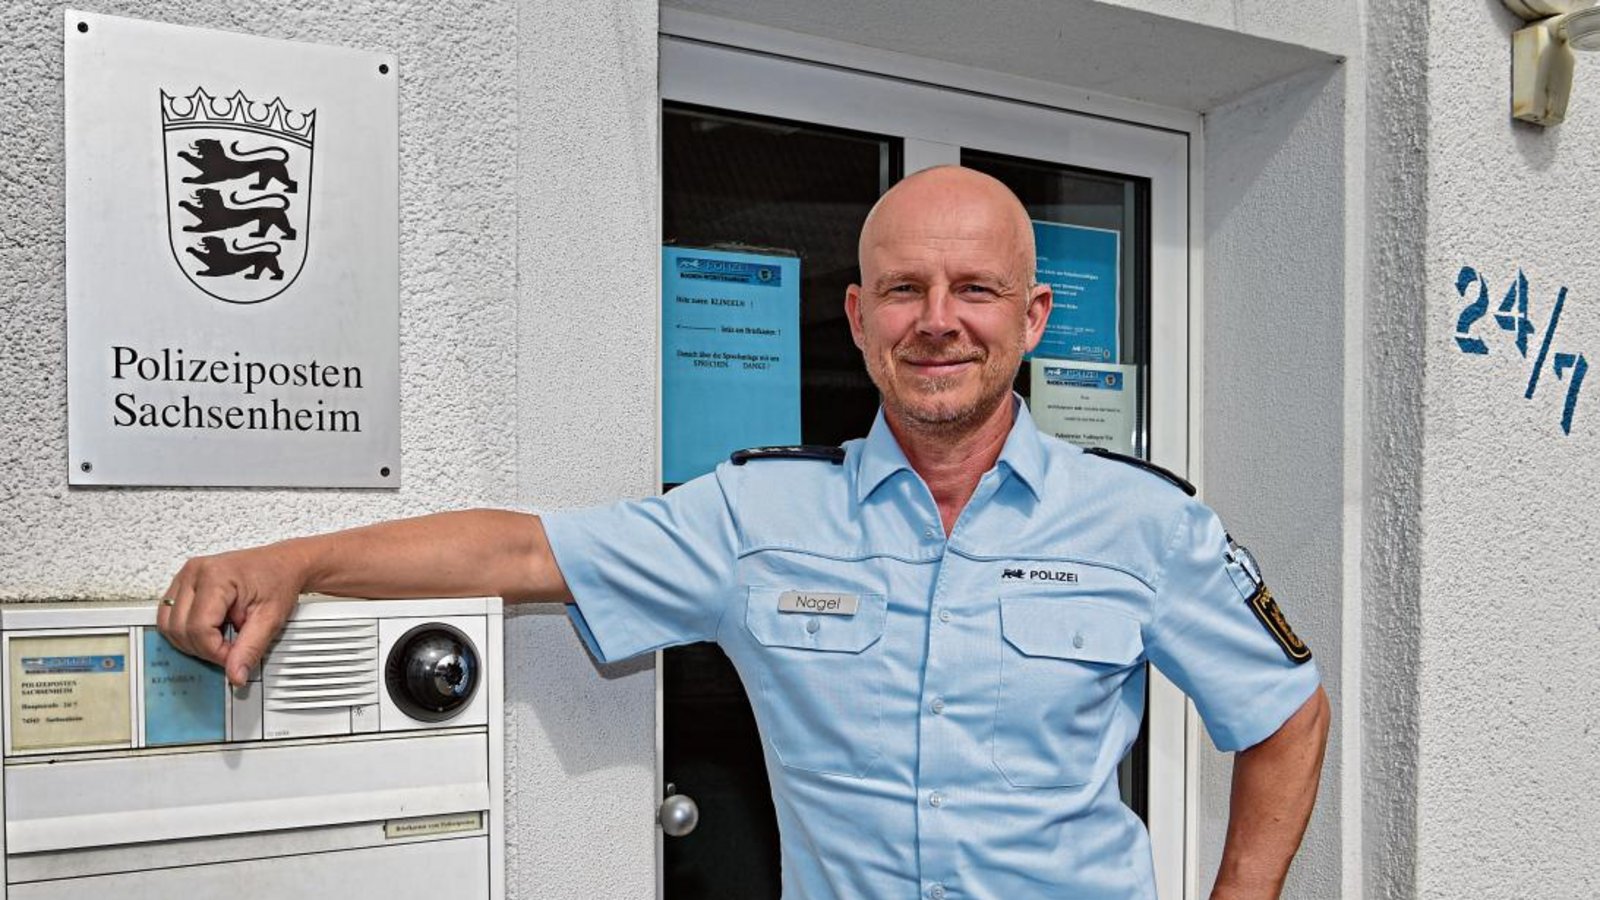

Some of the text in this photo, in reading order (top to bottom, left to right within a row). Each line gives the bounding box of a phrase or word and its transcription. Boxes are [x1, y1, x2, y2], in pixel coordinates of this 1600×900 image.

[1454, 265, 1589, 437] 24/7
[111, 346, 363, 394] Polizeiposten
[113, 393, 363, 432] Sachsenheim
[1030, 570, 1078, 582] POLIZEI
[796, 595, 841, 611] Nagel
[21, 680, 77, 688] POLIZEIPOSTEN
[21, 687, 74, 696] SACHSENHEIM
